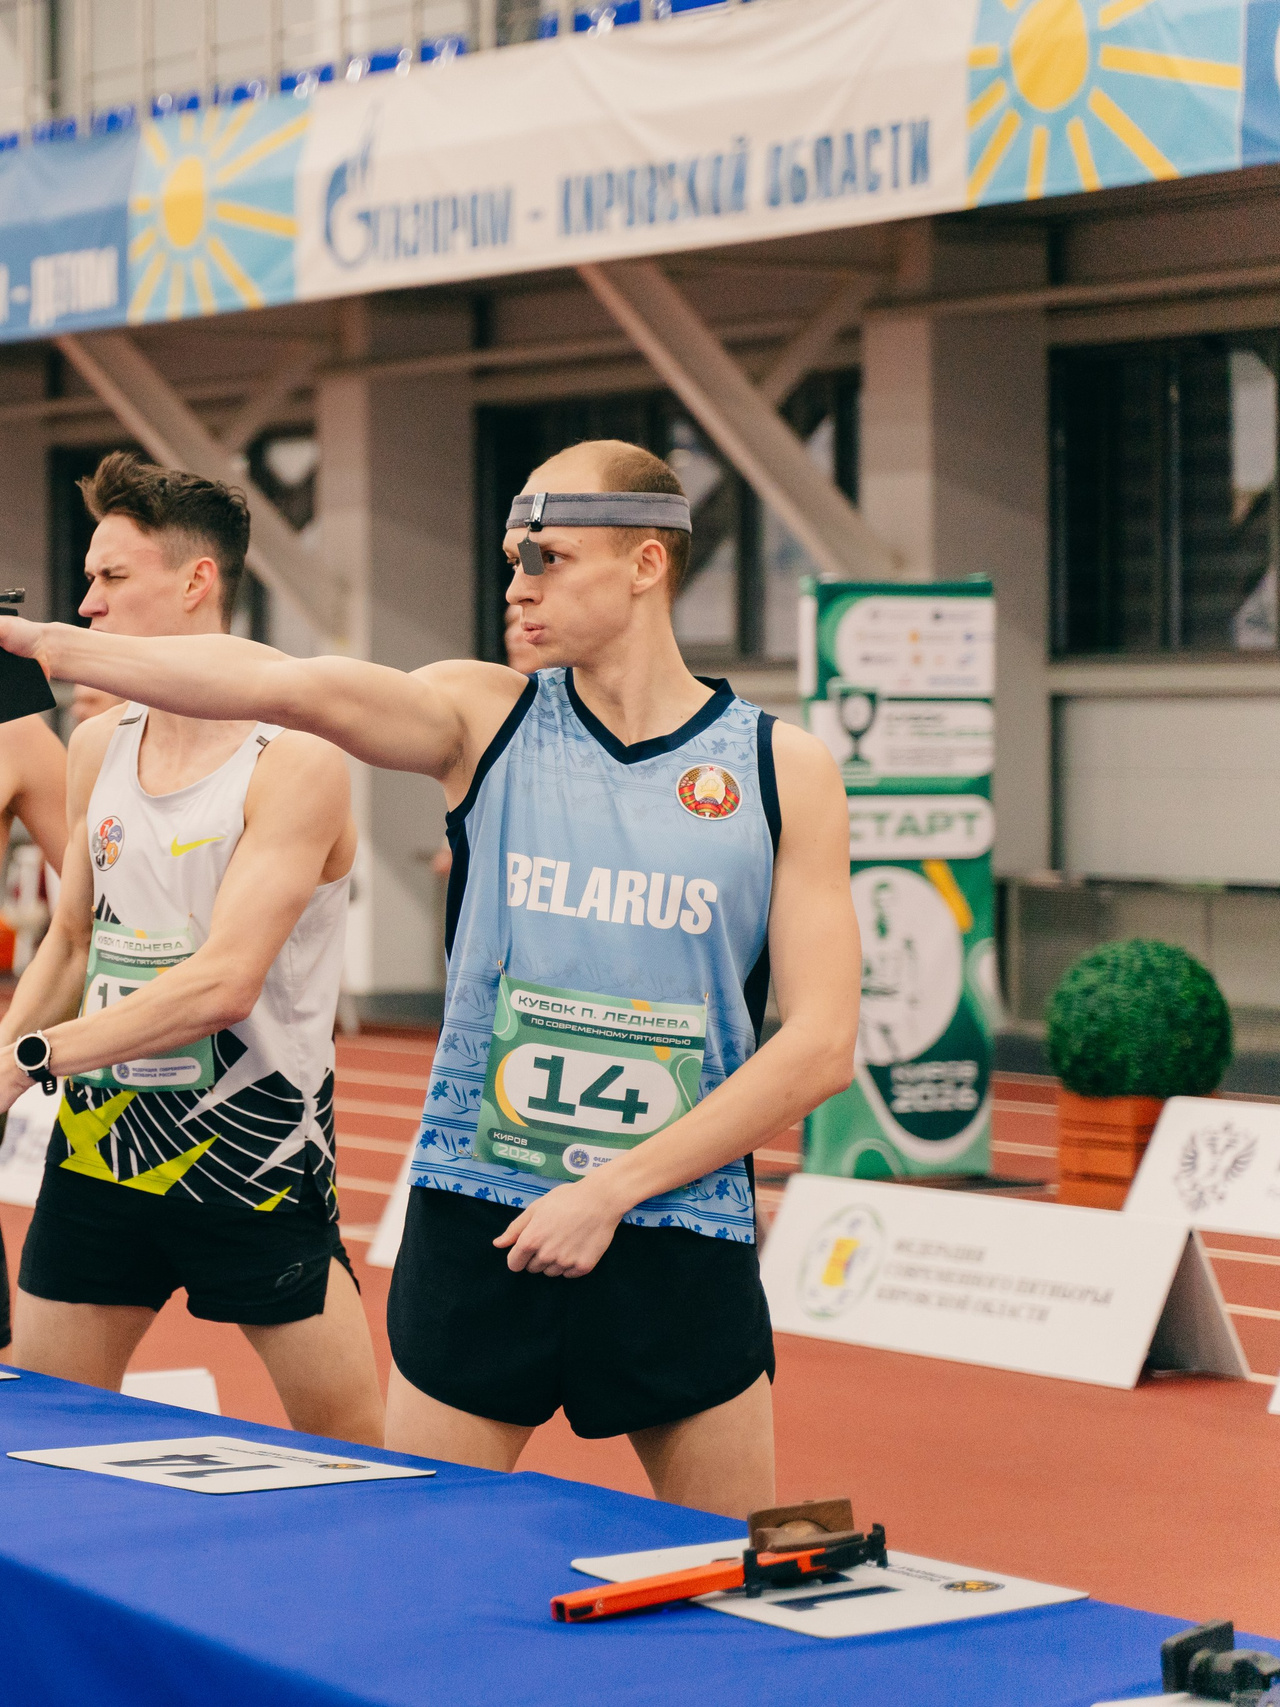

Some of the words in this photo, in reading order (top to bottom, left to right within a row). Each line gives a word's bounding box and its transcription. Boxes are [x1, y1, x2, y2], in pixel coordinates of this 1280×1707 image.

[767, 116, 930, 208] ОБЛАСТИ
[506, 851, 717, 935] BELARUS
[123, 941, 184, 952] ЛЕДНЕВА
[518, 996, 575, 1016] КУБОК
[581, 1008, 597, 1019] П.
[602, 1011, 691, 1030] ЛЕДНЕВА
[531, 1018, 544, 1026] ПО
[545, 1020, 628, 1040] СОВРЕМЕННОМУ
[629, 1033, 691, 1046] ПЯТИБОРЬЮ
[527, 1055, 649, 1125] 14
[493, 1131, 528, 1146] КИРОВ
[497, 1146, 541, 1165] 2026
[101, 1454, 286, 1479] 14
